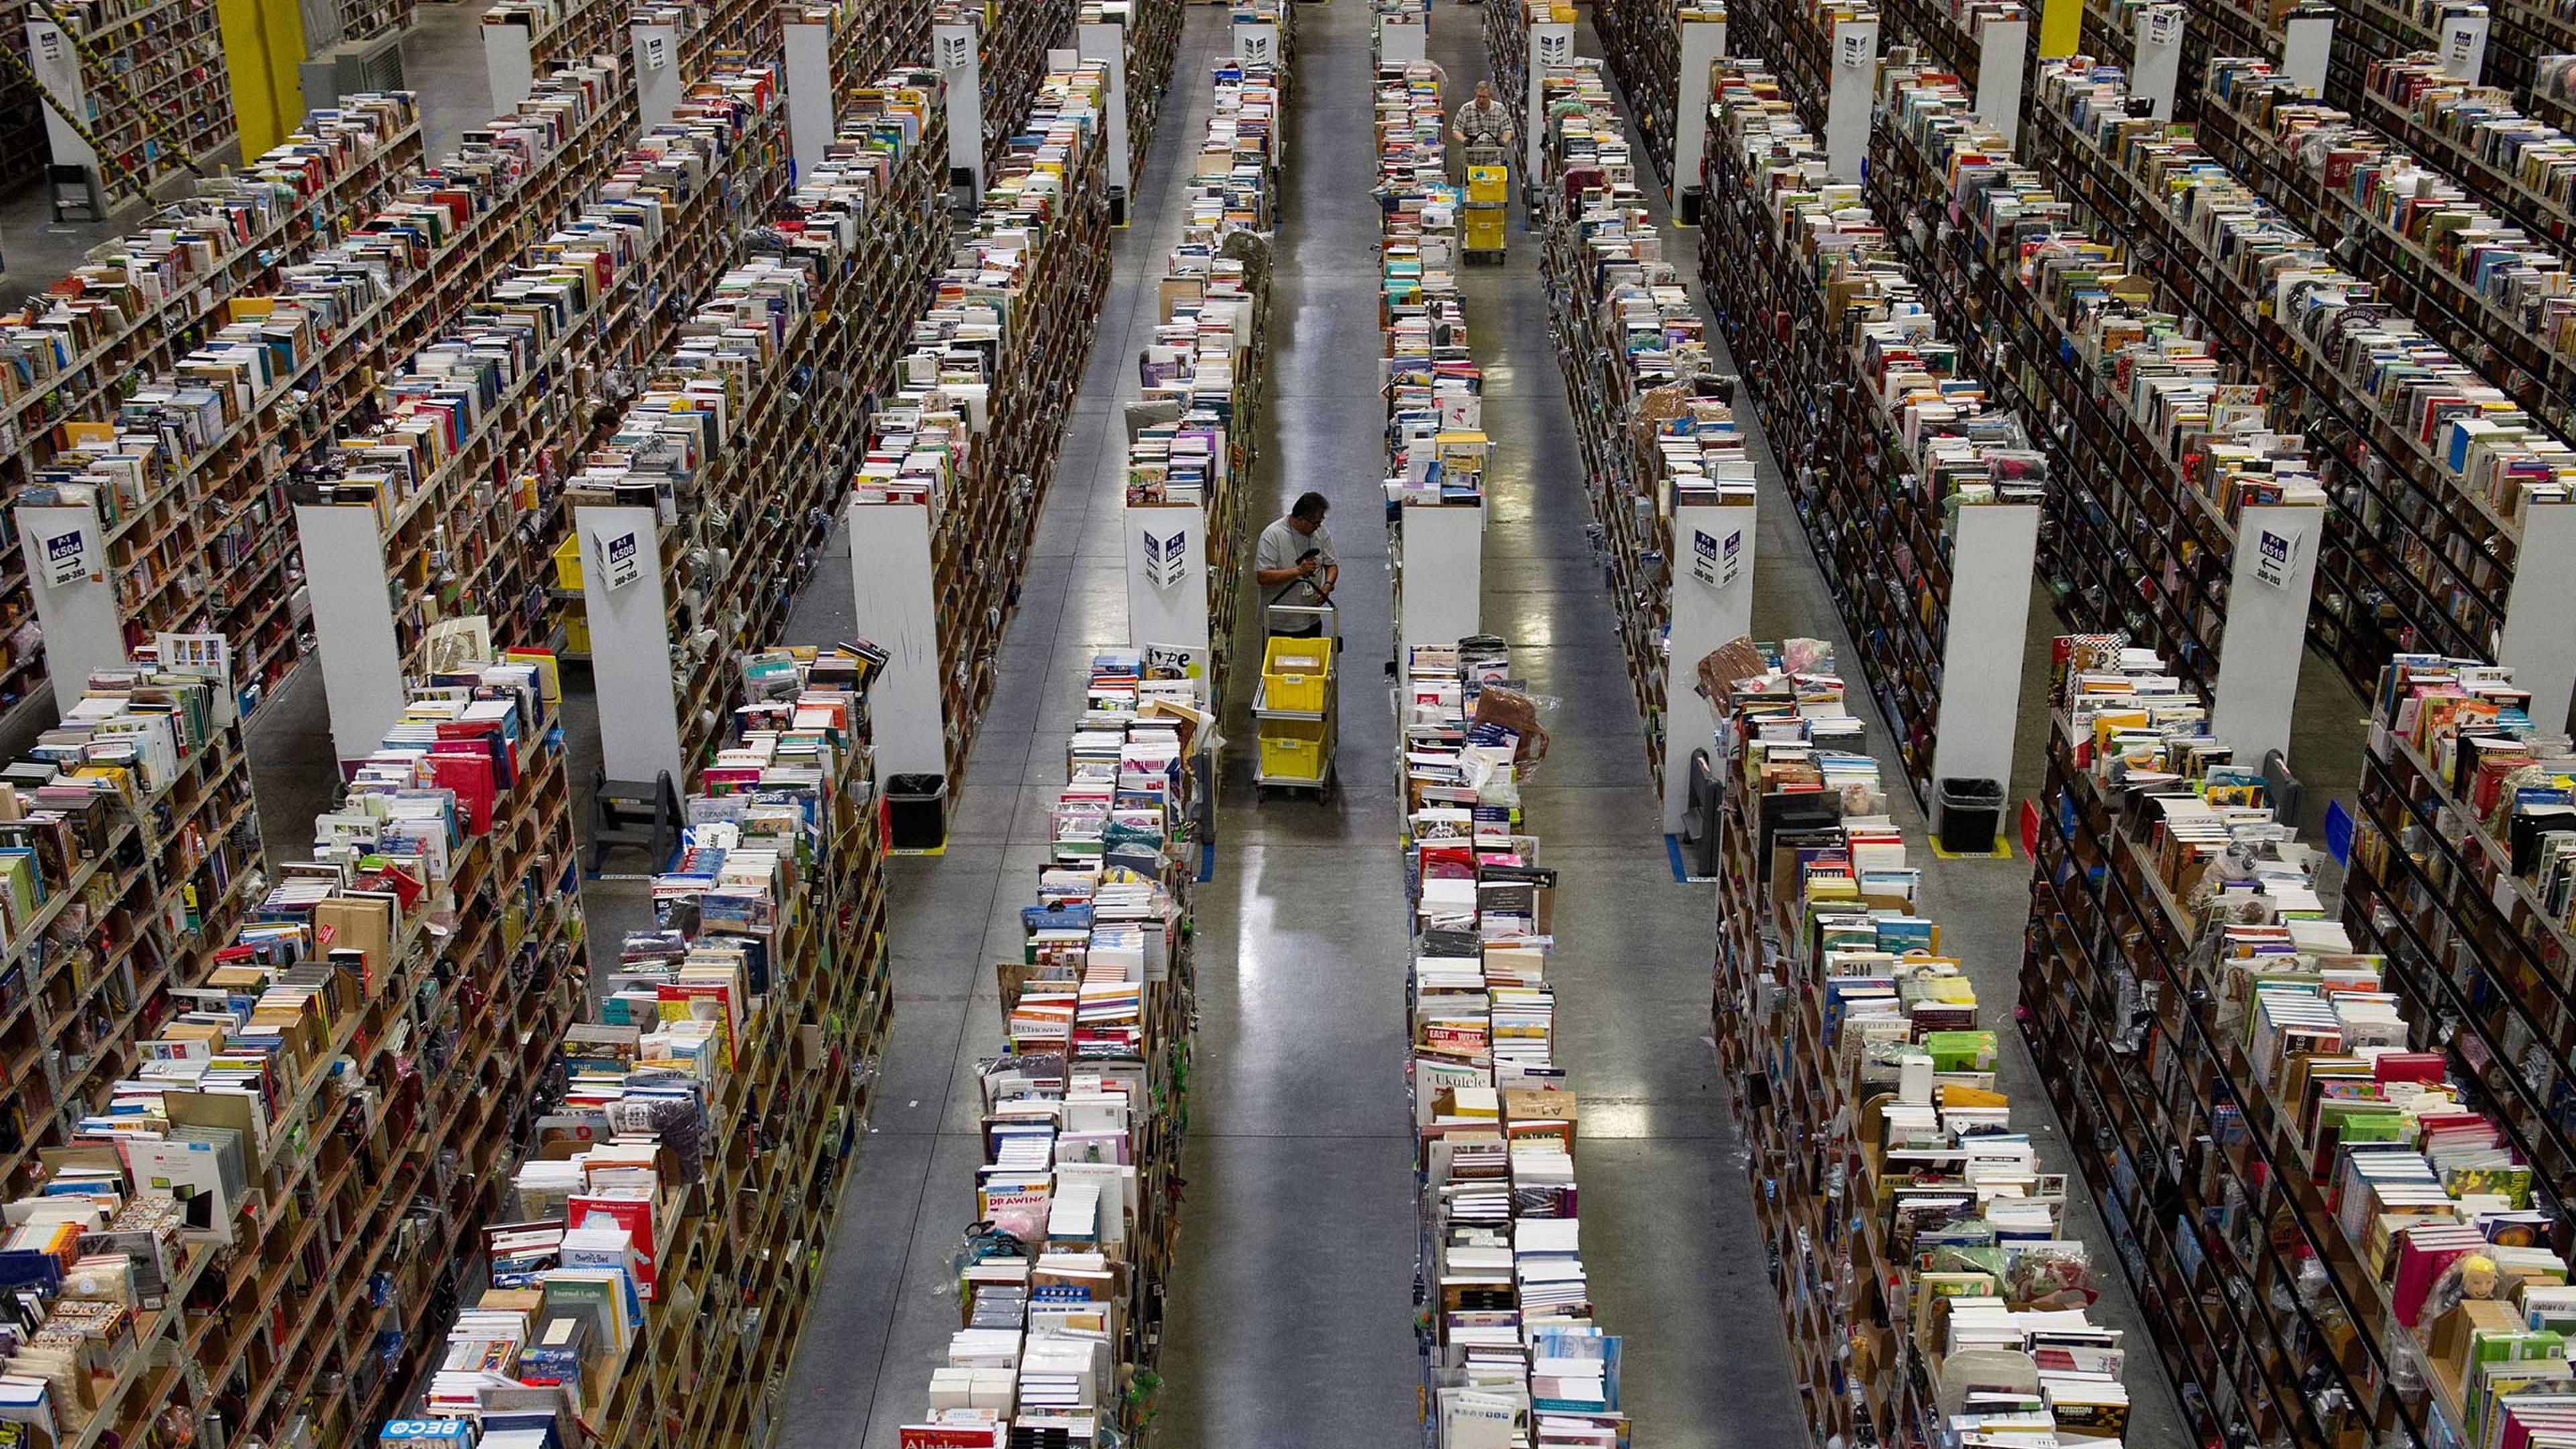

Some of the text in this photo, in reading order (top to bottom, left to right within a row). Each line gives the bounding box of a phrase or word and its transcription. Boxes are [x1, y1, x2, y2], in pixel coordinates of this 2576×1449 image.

[111, 470, 130, 478] Peru
[57, 535, 70, 546] P-1
[616, 537, 627, 547] P-1
[2269, 536, 2279, 547] P-1
[51, 541, 81, 559] K504
[611, 543, 635, 561] K508
[1167, 543, 1184, 560] K512
[1696, 541, 1715, 559] K515
[2262, 542, 2285, 561] K519
[1147, 647, 1190, 668] type
[1014, 1024, 1061, 1033] BEETHOVEN
[1430, 1030, 1449, 1040] EAST
[1457, 1033, 1481, 1041] WEST
[1435, 1074, 1486, 1089] Ukulele
[390, 1421, 460, 1434] BECO
